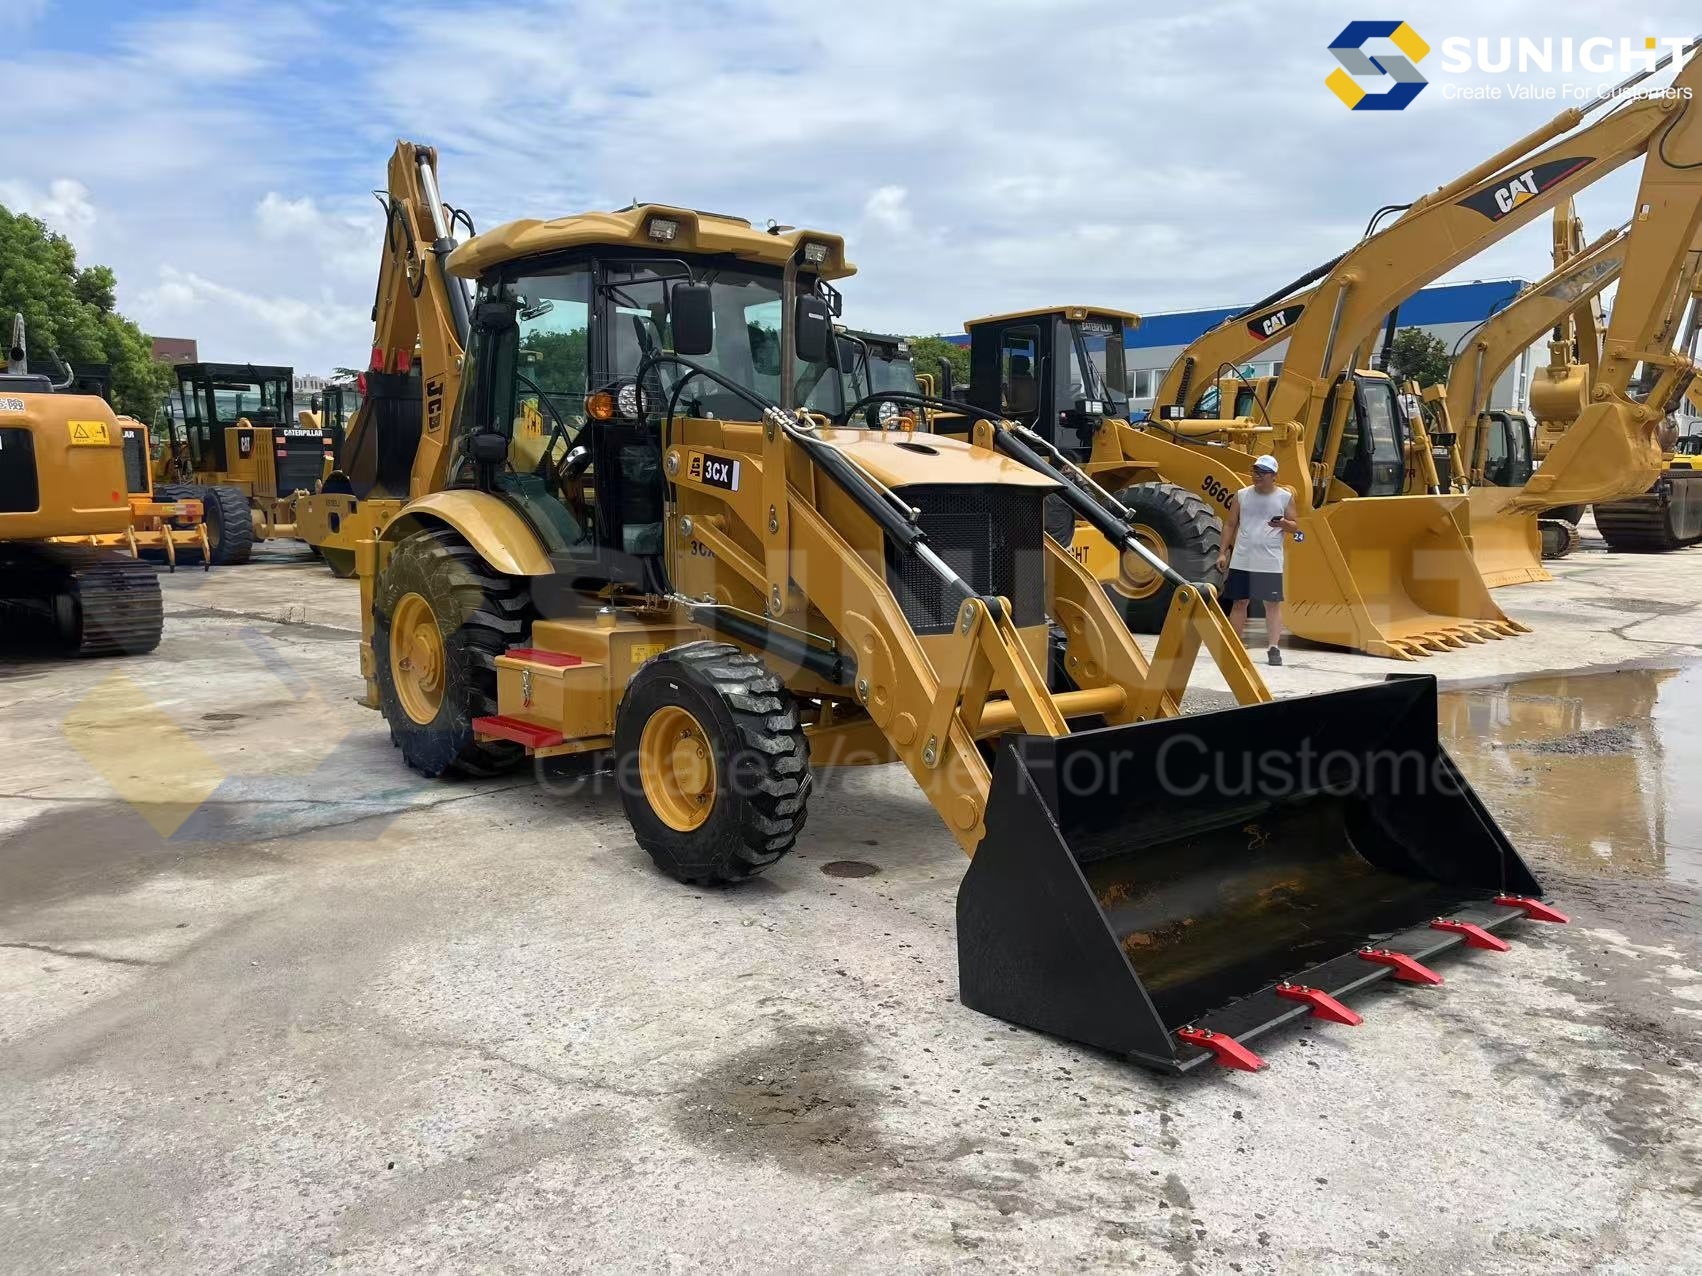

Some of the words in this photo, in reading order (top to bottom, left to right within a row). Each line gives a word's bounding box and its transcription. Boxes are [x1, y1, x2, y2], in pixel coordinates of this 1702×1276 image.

[1494, 170, 1539, 214] CAT
[1262, 310, 1287, 335] CAT
[426, 380, 444, 430] JCB
[283, 429, 323, 437] CATERPILLAR
[689, 456, 701, 478] JCB
[705, 461, 728, 483] 3CX
[1293, 532, 1304, 541] 24
